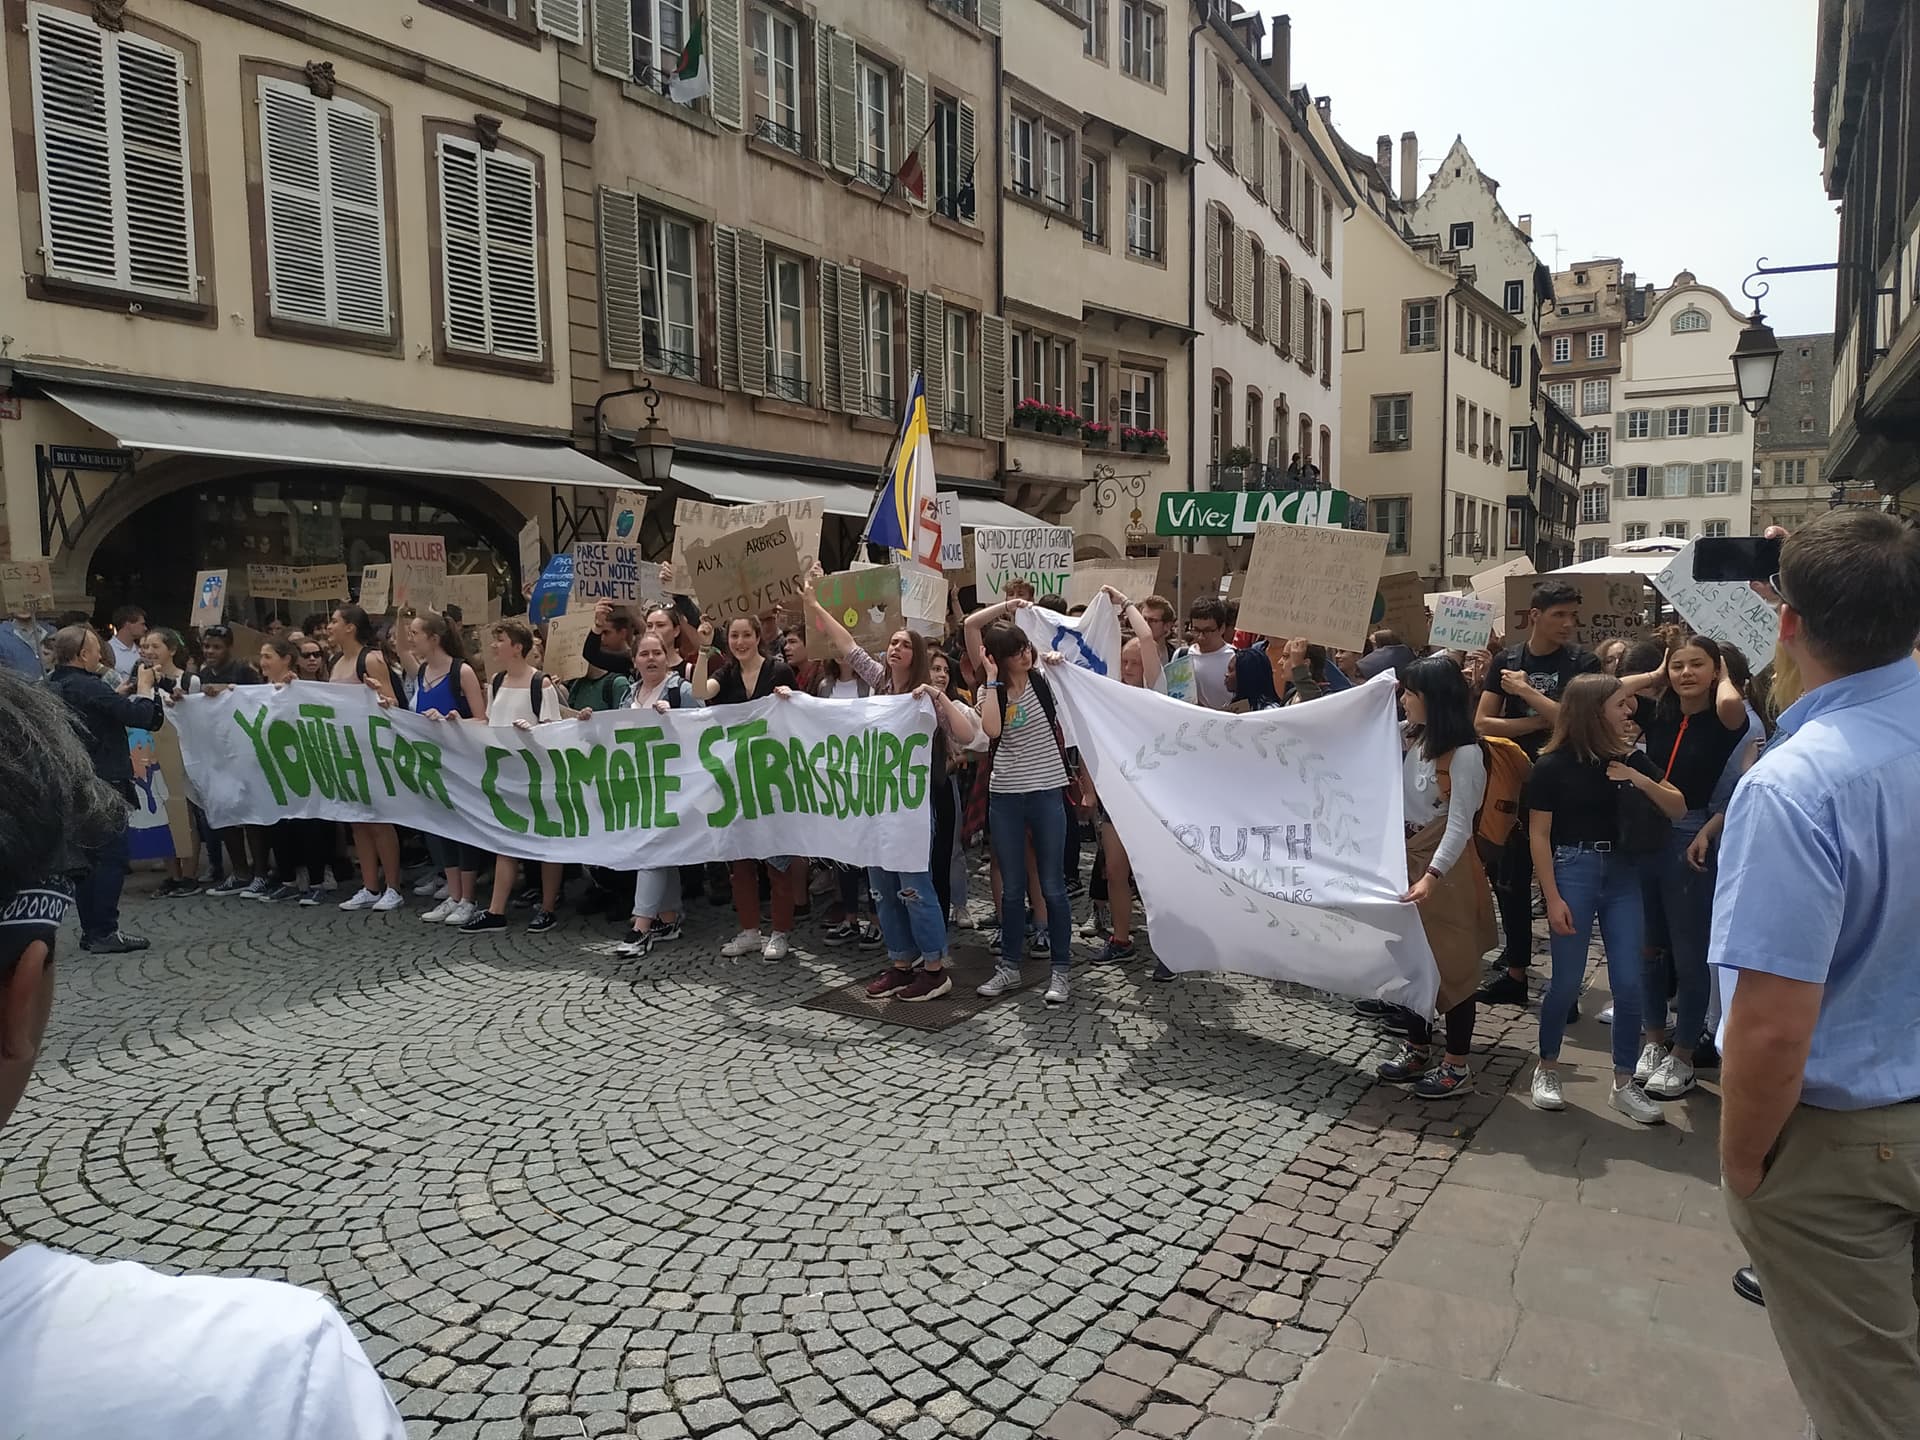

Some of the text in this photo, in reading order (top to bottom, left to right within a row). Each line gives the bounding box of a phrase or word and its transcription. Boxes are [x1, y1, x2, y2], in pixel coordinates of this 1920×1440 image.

[56, 451, 77, 463] RUE
[1167, 490, 1342, 534] Vivez LOCAL
[746, 530, 787, 556] ARBRES
[1007, 530, 1020, 549] JE
[393, 541, 445, 562] POLLUER
[577, 545, 637, 564] PARCE QUE
[991, 553, 1008, 569] JE
[1011, 552, 1035, 569] VEUX
[609, 564, 639, 581] NOTRE
[697, 553, 723, 576] AUX
[580, 581, 636, 600] PLANETE
[705, 574, 804, 621] CITOYENS
[1441, 597, 1492, 611] SAVE OUR
[1444, 607, 1486, 620] PLANET
[1592, 614, 1621, 628] EST
[1434, 626, 1488, 646] GO VEGAN
[233, 704, 930, 838] YOUTH FOR CLIMATE STRASBOURG
[1173, 823, 1312, 862] OUTH
[1231, 865, 1305, 888] IMATE
